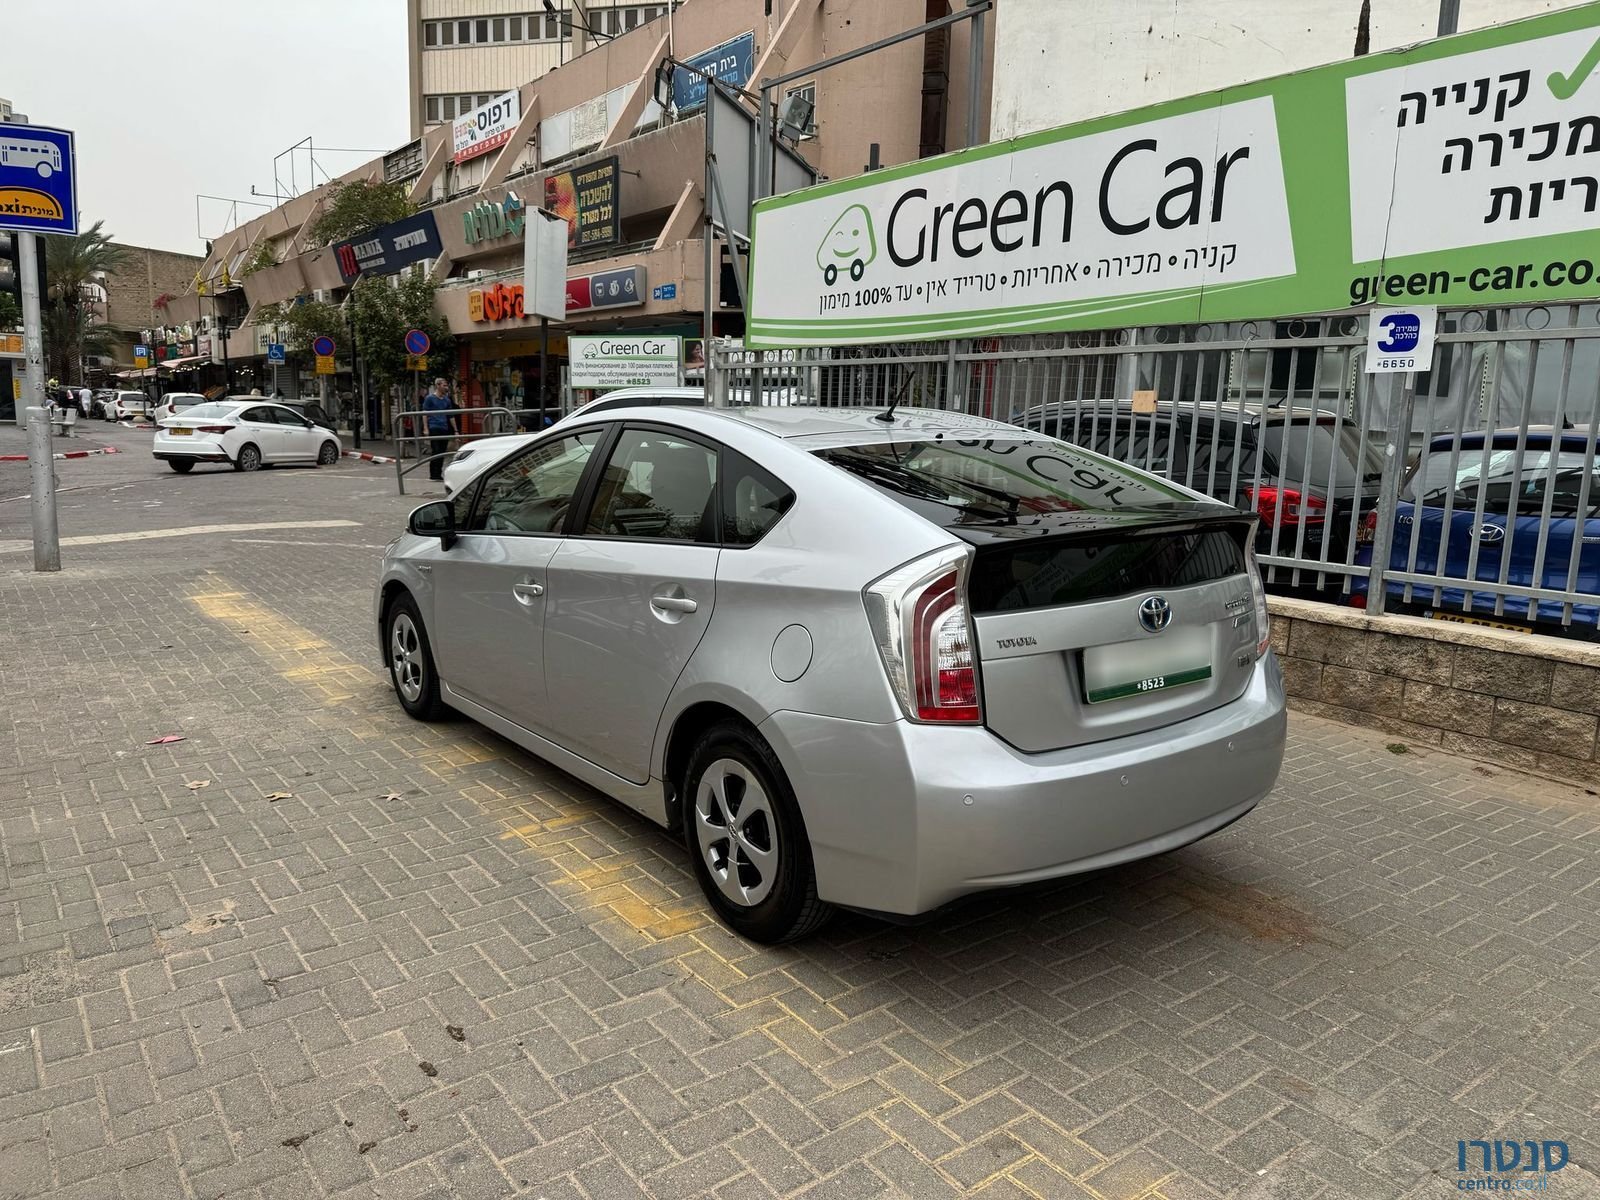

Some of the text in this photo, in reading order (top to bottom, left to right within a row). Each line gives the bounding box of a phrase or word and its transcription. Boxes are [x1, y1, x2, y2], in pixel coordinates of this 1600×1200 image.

[720, 55, 737, 72] בית
[1397, 69, 1531, 128] קנייה
[477, 98, 511, 131] דפוס
[887, 139, 1250, 267] Green Car
[1483, 176, 1599, 224] ריות
[21, 204, 54, 216] מונית
[819, 244, 1237, 315] קניה מכירה אחריות טרייד אין עד 100% מימון
[1395, 332, 1417, 340] כהלכה
[1396, 325, 1418, 333] שמירה
[600, 340, 665, 355] Green Car
[996, 636, 1037, 650] TOYOTA
